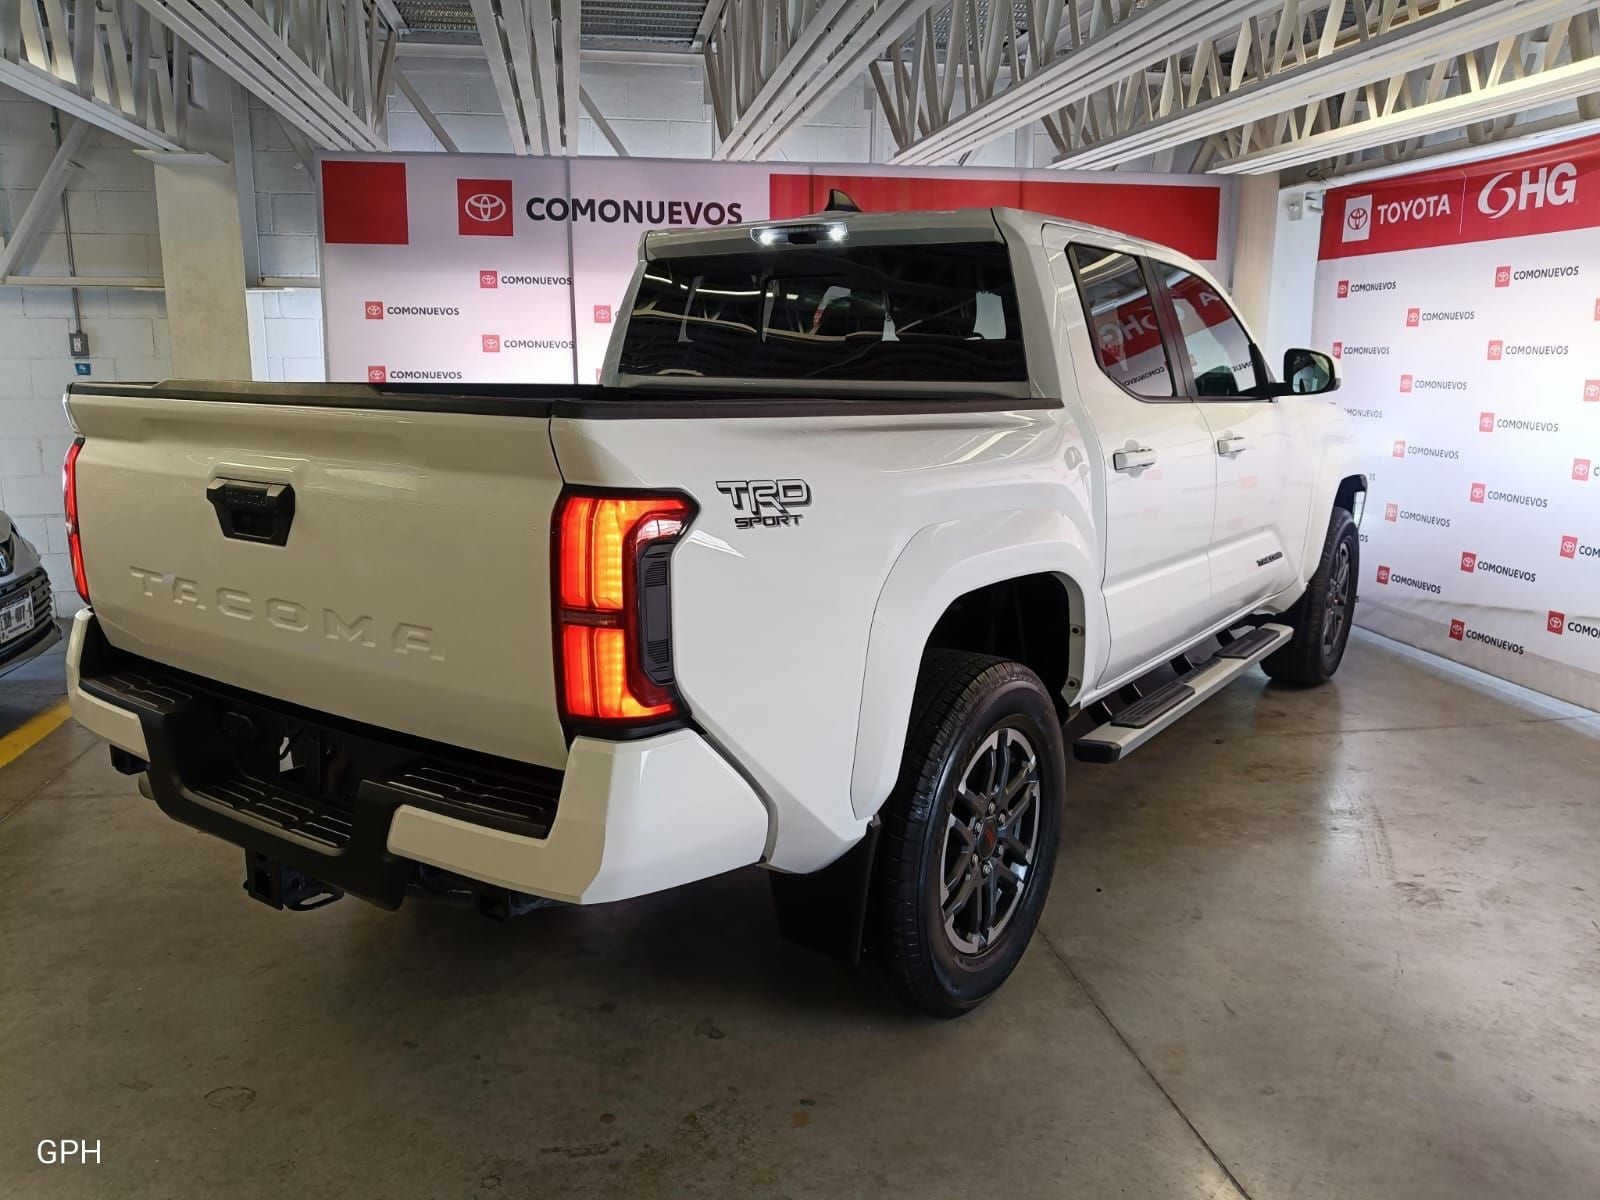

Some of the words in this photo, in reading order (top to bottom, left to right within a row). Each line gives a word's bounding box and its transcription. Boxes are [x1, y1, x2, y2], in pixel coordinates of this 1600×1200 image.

[526, 197, 742, 226] COMONUEVOS
[1377, 194, 1451, 225] TOYOTA
[1513, 266, 1579, 281] COMONUEVOS
[501, 276, 572, 286] COMONUEVOS
[1350, 281, 1397, 293] COMONUEVOS
[387, 306, 460, 316] COMONUEVOS
[1421, 311, 1475, 322] COMONUEVOS
[503, 339, 575, 350] COMONUEVOS
[1343, 346, 1390, 355] COMONUEVOS
[1505, 345, 1569, 356] COMONUEVOS
[390, 369, 462, 381] COMONUEVOS
[1414, 380, 1467, 391] COMONUEVOS
[1496, 419, 1559, 433] COMONUEVOS
[1407, 446, 1459, 460] COMONUEVOS
[716, 478, 812, 516] TRD
[1487, 490, 1548, 508] COMONUEVOS
[734, 514, 803, 529] SPORT
[1399, 510, 1451, 528] COMONUEVOS
[1477, 561, 1537, 583] COMONUEVOS
[1390, 573, 1441, 595] COMONUEVOS
[129, 566, 445, 661] TACOMA
[1465, 629, 1525, 655] COMONUEVOS
